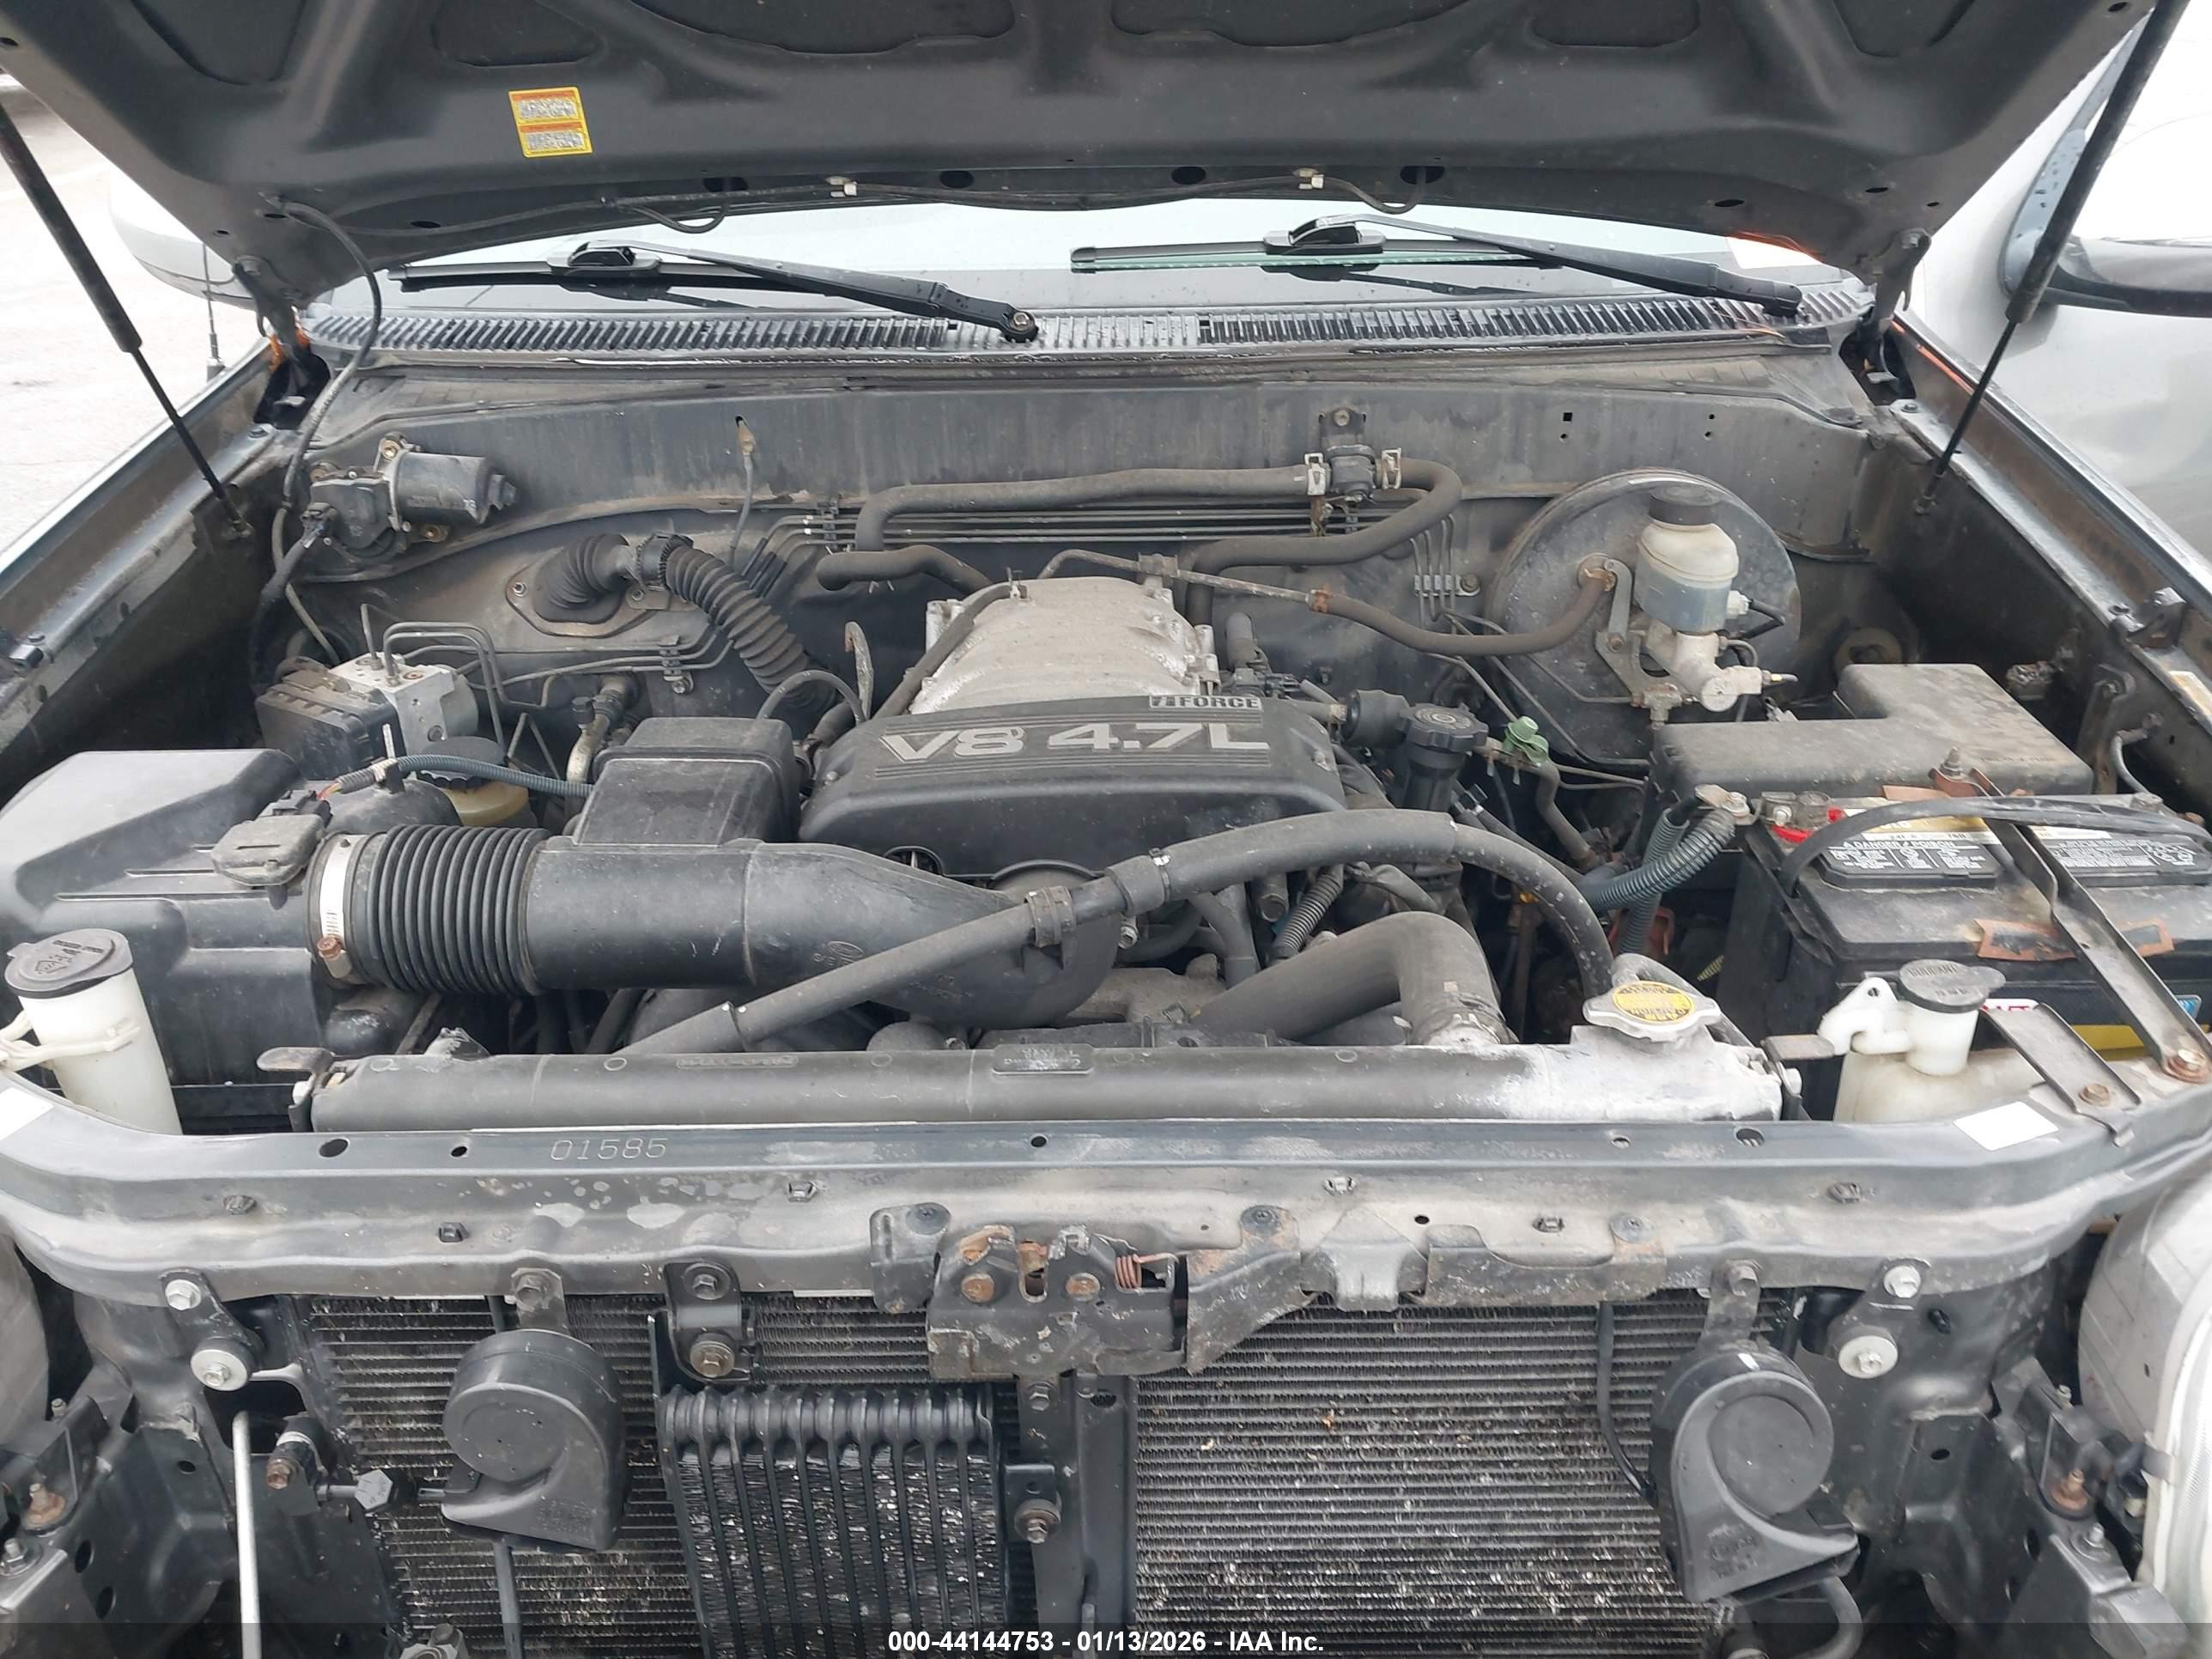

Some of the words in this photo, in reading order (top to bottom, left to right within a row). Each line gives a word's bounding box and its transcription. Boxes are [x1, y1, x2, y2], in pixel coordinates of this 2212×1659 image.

[879, 726, 1025, 763] V8
[1047, 722, 1271, 750] 4.7L
[550, 1138, 669, 1161] 01585
